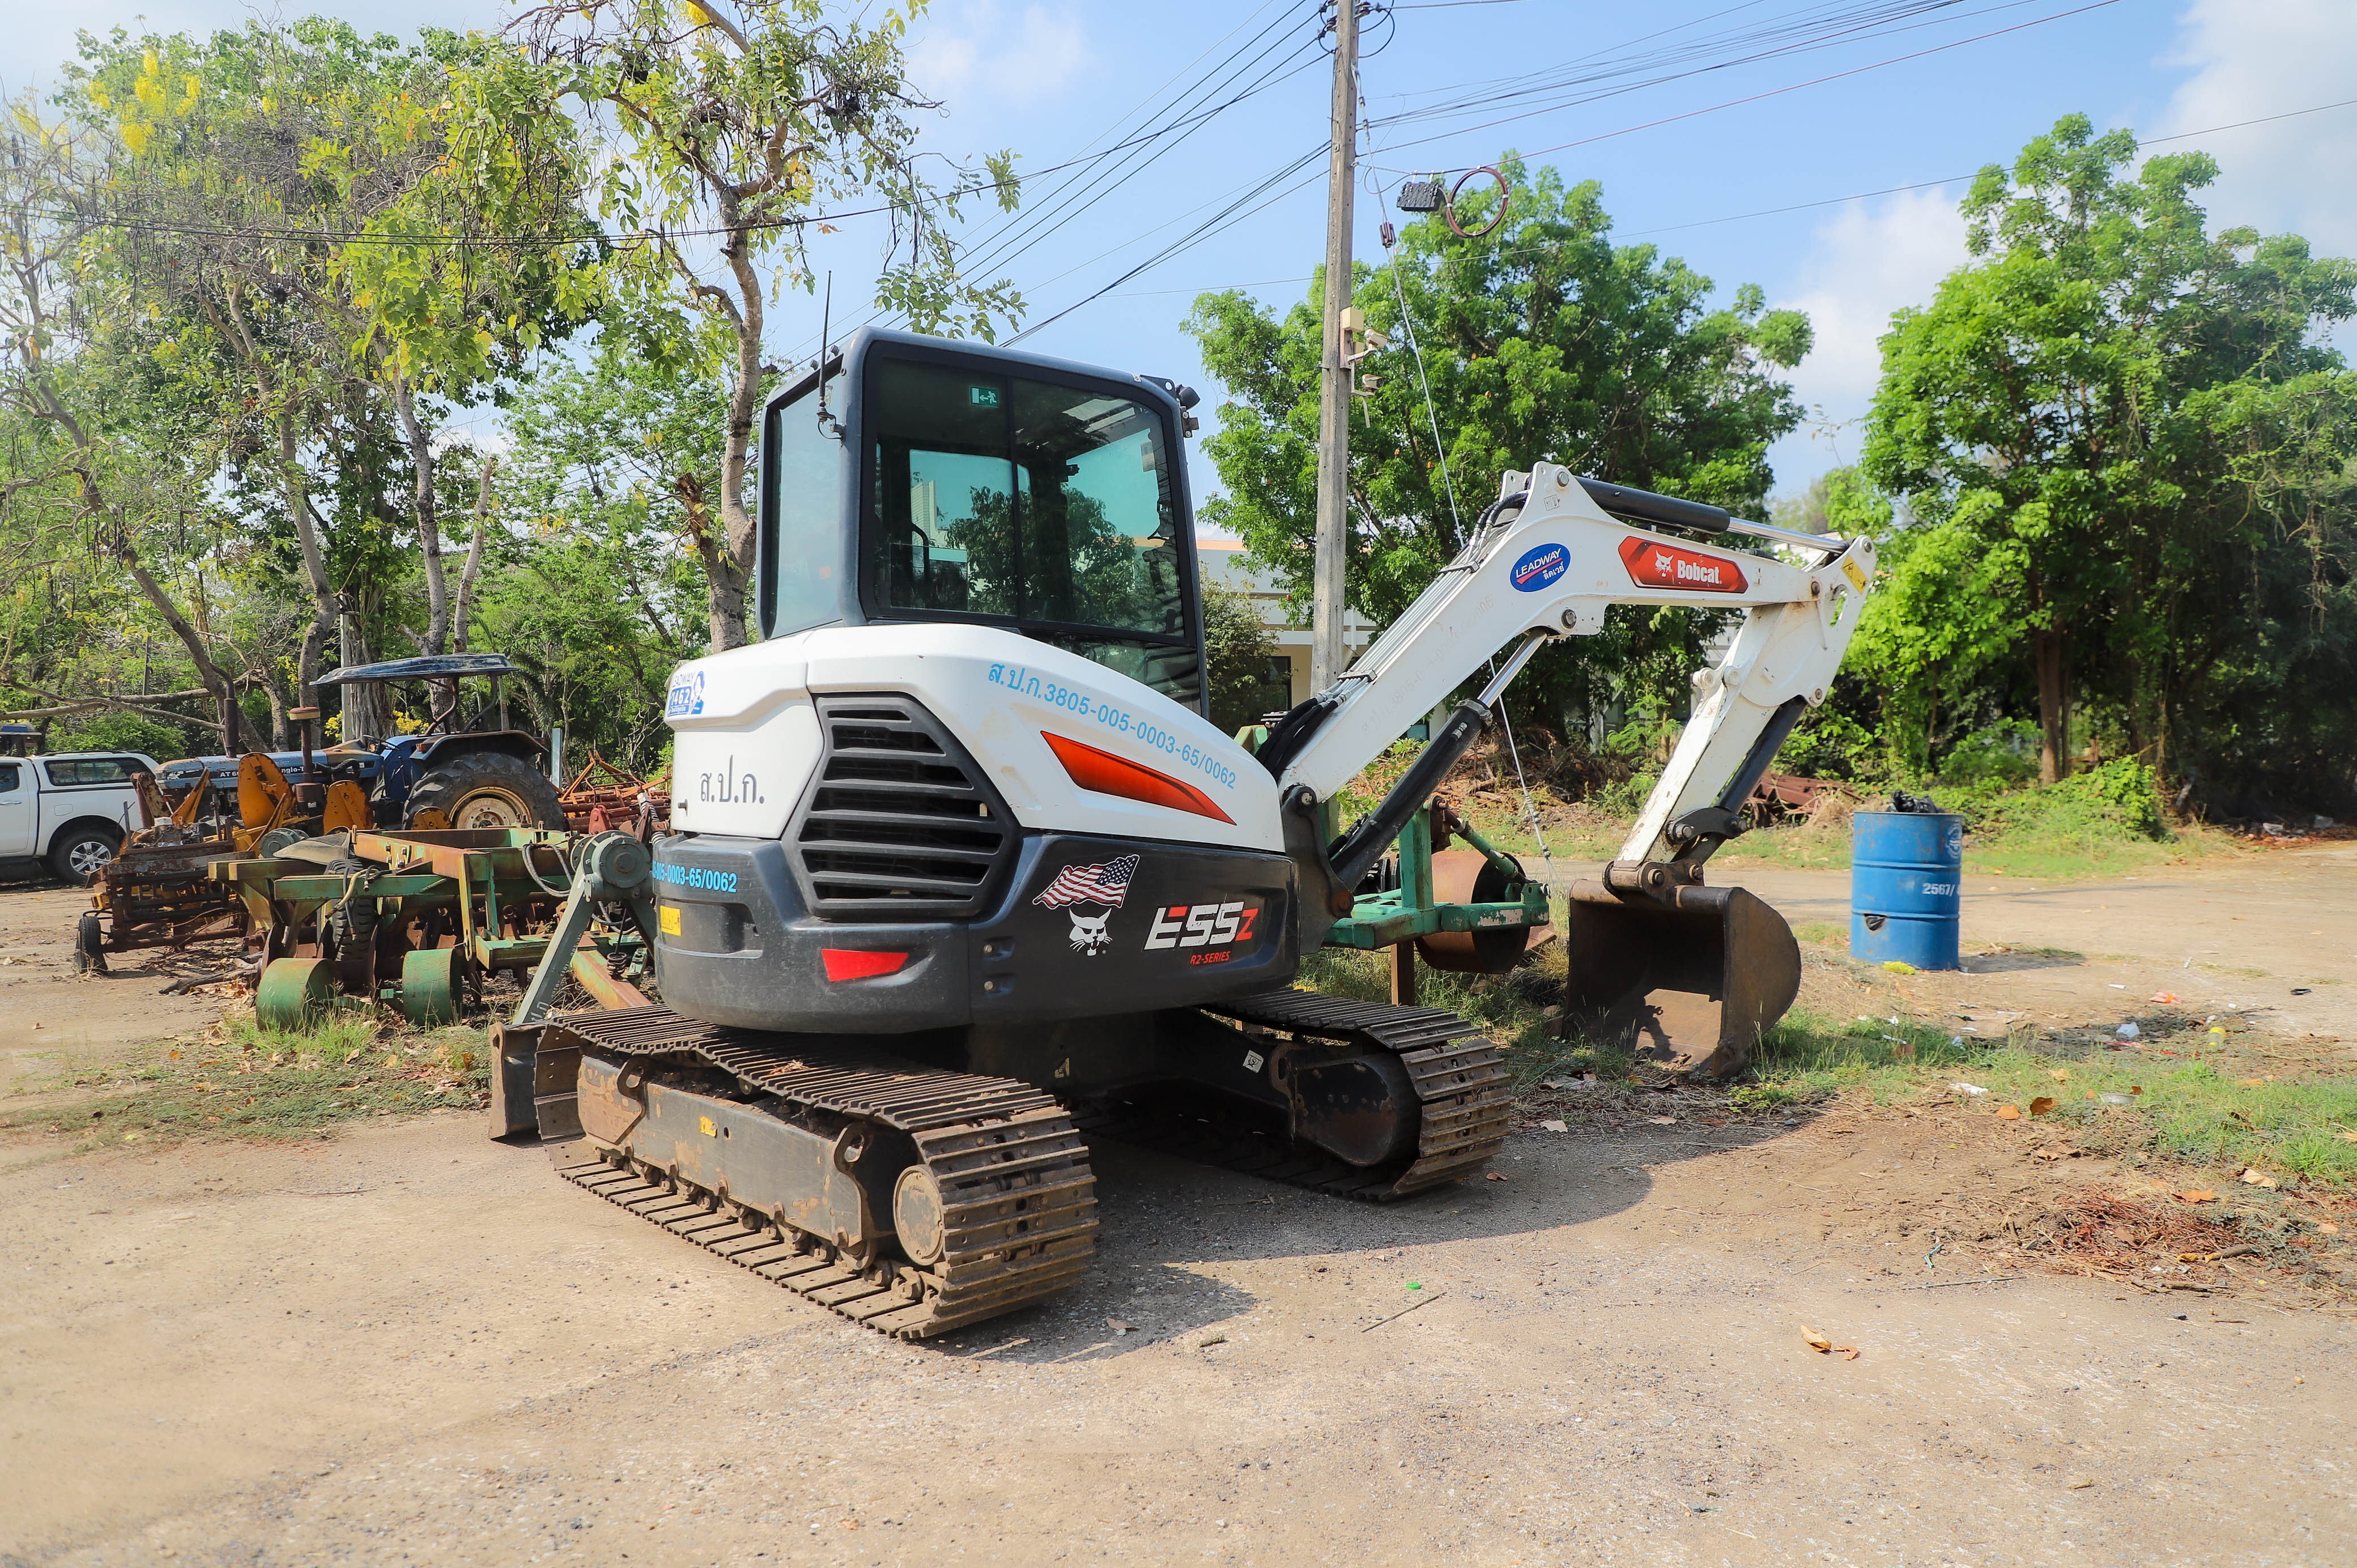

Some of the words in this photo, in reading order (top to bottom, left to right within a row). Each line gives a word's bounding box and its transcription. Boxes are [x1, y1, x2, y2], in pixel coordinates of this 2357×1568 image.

[1516, 548, 1562, 578] LEADWAY
[1678, 559, 1719, 584] Bobcat
[988, 663, 1236, 789] ส.ป.ก.3805-005-0003-65/0062
[701, 754, 764, 804] ส.ป.ก.
[1190, 951, 1231, 965] R2-SERIES
